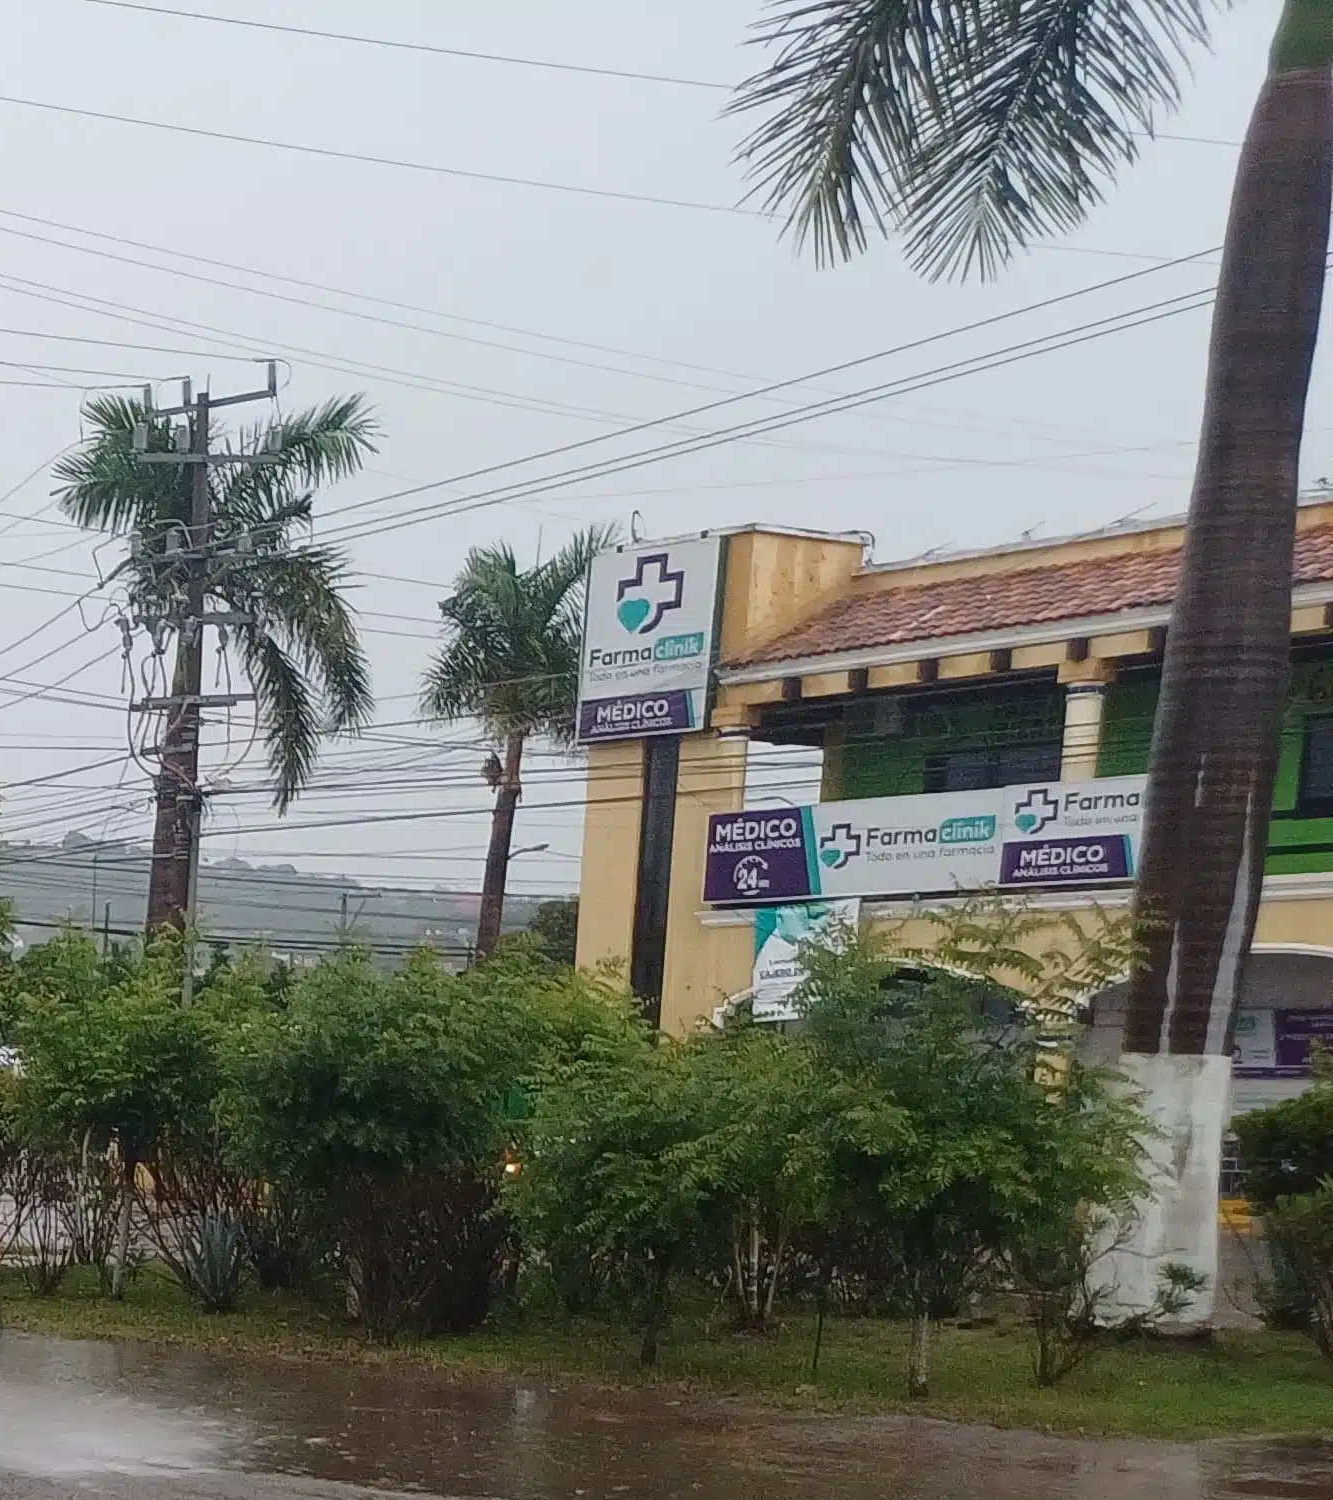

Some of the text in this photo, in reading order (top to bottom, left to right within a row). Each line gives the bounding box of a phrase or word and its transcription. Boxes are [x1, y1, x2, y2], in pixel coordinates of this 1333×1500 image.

[596, 700, 669, 723] MÉDICO
[715, 818, 797, 842] MÉDICO
[866, 845, 994, 862] Todo en una farmacia
[1020, 843, 1104, 867] MÉDICO
[737, 867, 758, 889] 24
